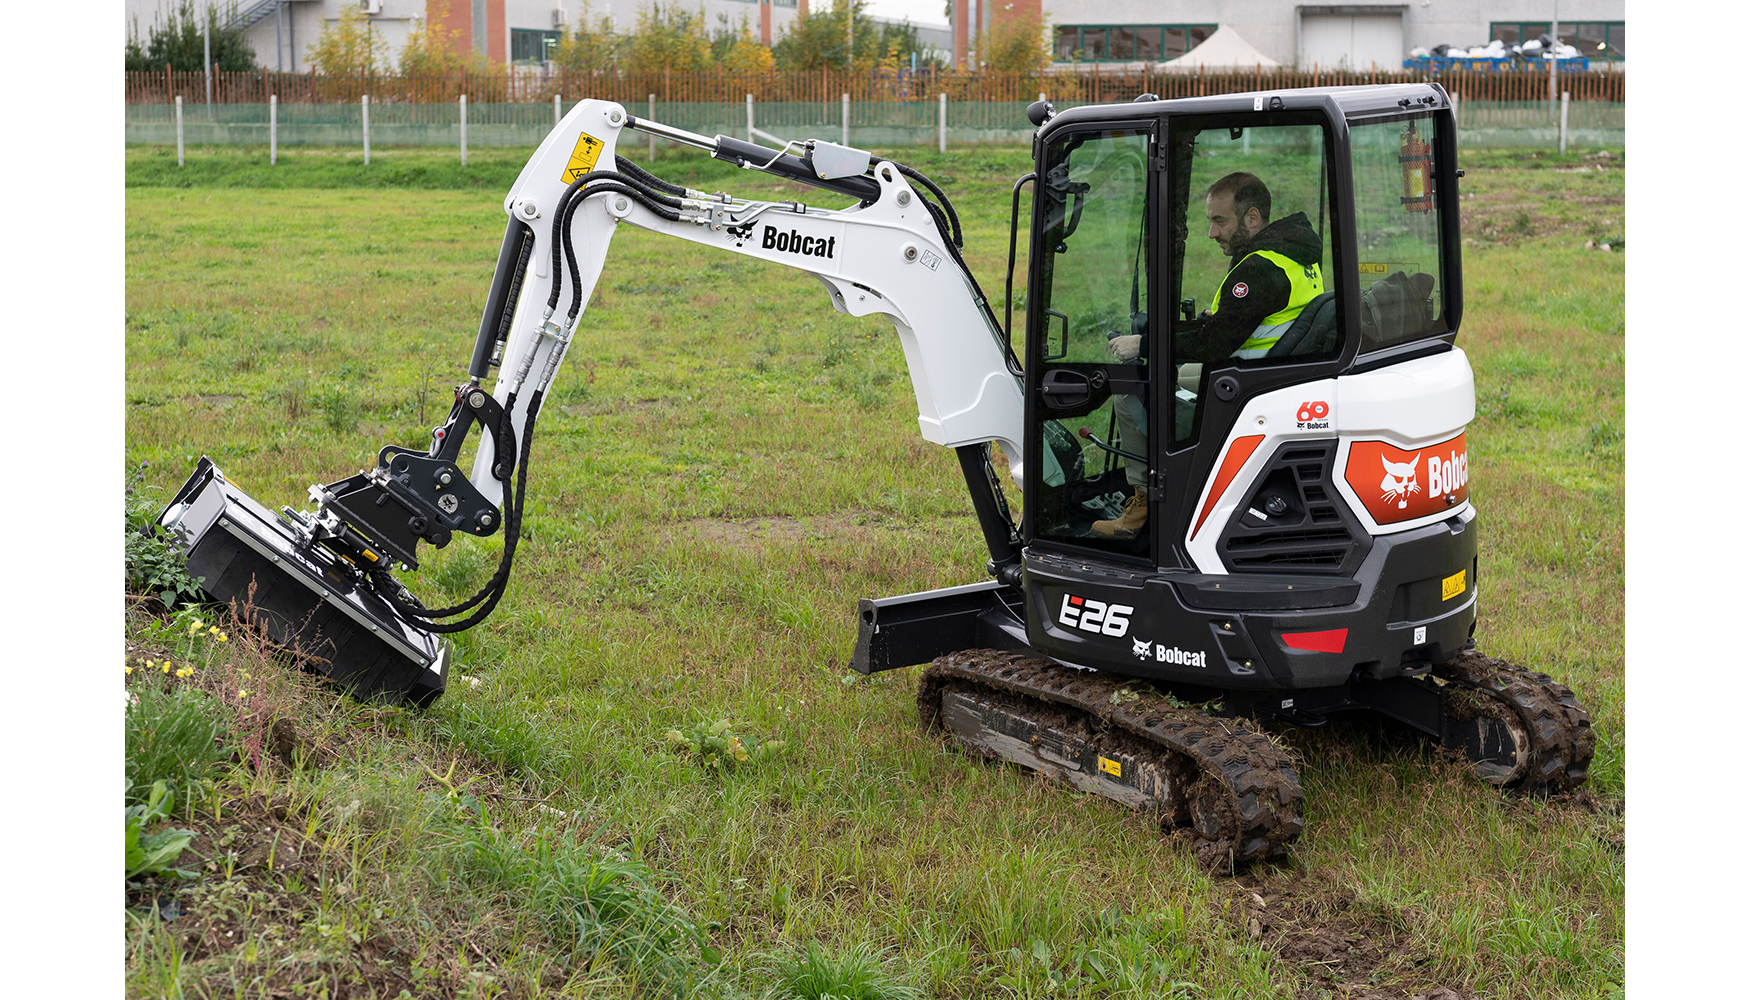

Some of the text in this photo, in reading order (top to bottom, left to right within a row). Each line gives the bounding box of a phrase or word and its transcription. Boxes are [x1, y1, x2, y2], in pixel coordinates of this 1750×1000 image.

[762, 225, 835, 259] Bobcat
[1296, 401, 1329, 422] 60
[1307, 422, 1329, 430] Bobcat
[1427, 450, 1468, 499] Bobca
[1058, 593, 1134, 638] E26
[1156, 644, 1207, 668] Bobcat
